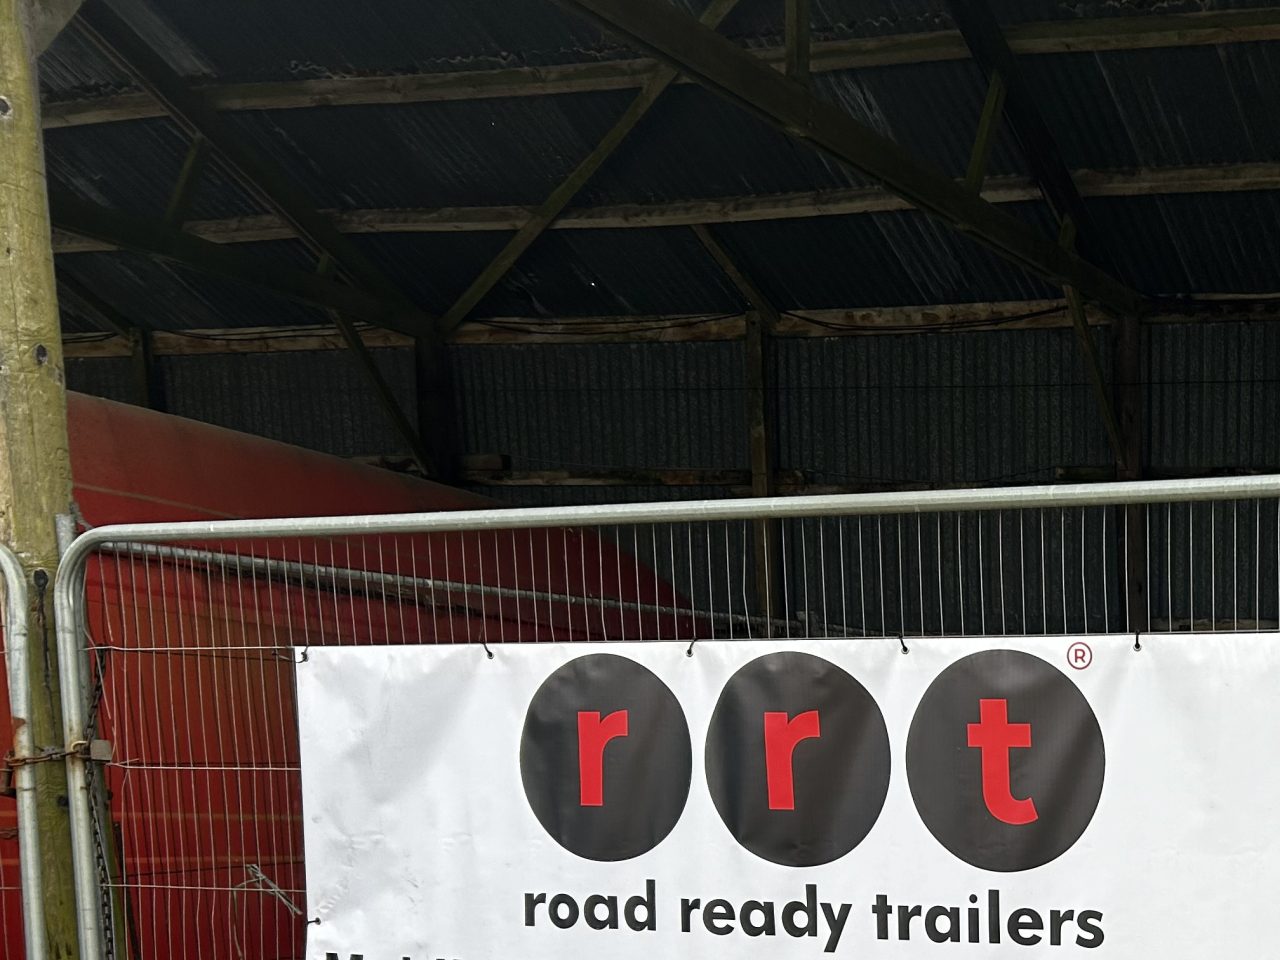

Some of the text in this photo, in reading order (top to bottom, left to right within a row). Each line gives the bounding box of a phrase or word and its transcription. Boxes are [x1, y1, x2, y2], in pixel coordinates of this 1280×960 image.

[524, 879, 1105, 953] road ready trailers
